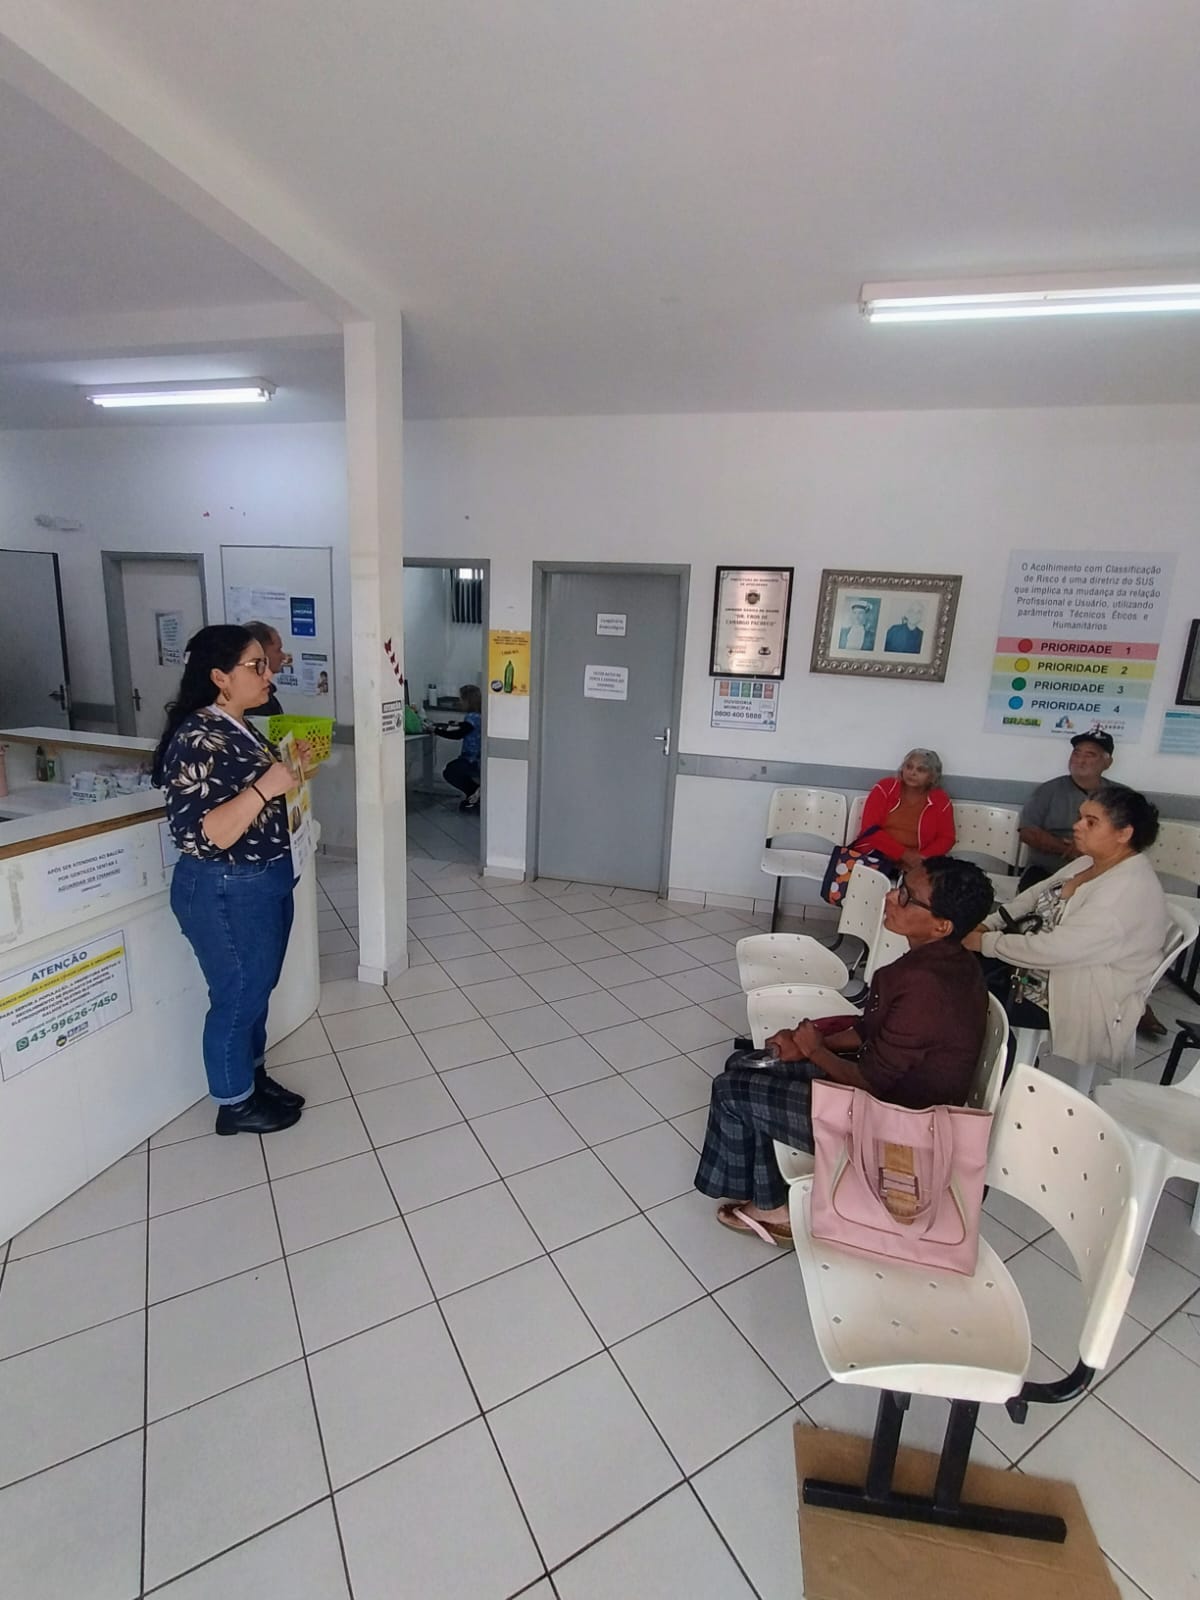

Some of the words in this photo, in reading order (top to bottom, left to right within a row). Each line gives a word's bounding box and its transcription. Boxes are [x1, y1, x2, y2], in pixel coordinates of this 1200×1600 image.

[1030, 563, 1082, 572] Acolhimento
[1105, 564, 1161, 575] Classificação
[1036, 575, 1059, 583] Risco
[1062, 575, 1066, 583] é
[1090, 576, 1120, 585] diretriz
[1136, 578, 1154, 586] SUS
[1014, 586, 1029, 594] que
[1031, 585, 1061, 596] implica
[1076, 588, 1114, 597] mudança
[1129, 589, 1161, 599] relação
[1017, 596, 1065, 606] Profissional
[1112, 601, 1154, 609] utilizando
[1017, 608, 1063, 617] parâmetros
[1070, 609, 1105, 619] Técnicos
[1112, 610, 1137, 620] Éticos
[1052, 621, 1107, 630] Humanitários
[1040, 642, 1112, 654] PRIORIDADE
[1037, 661, 1108, 674] PRIORIDADE
[1121, 666, 1128, 675] 2
[1034, 681, 1104, 693] PRIORIDADE
[1117, 686, 1124, 694] 3
[1031, 700, 1101, 712] PRIORIDADE
[1003, 717, 1040, 727] BRASIL
[31, 951, 88, 982] ATENÇÃO
[30, 992, 118, 1043] 43-99626-7450
